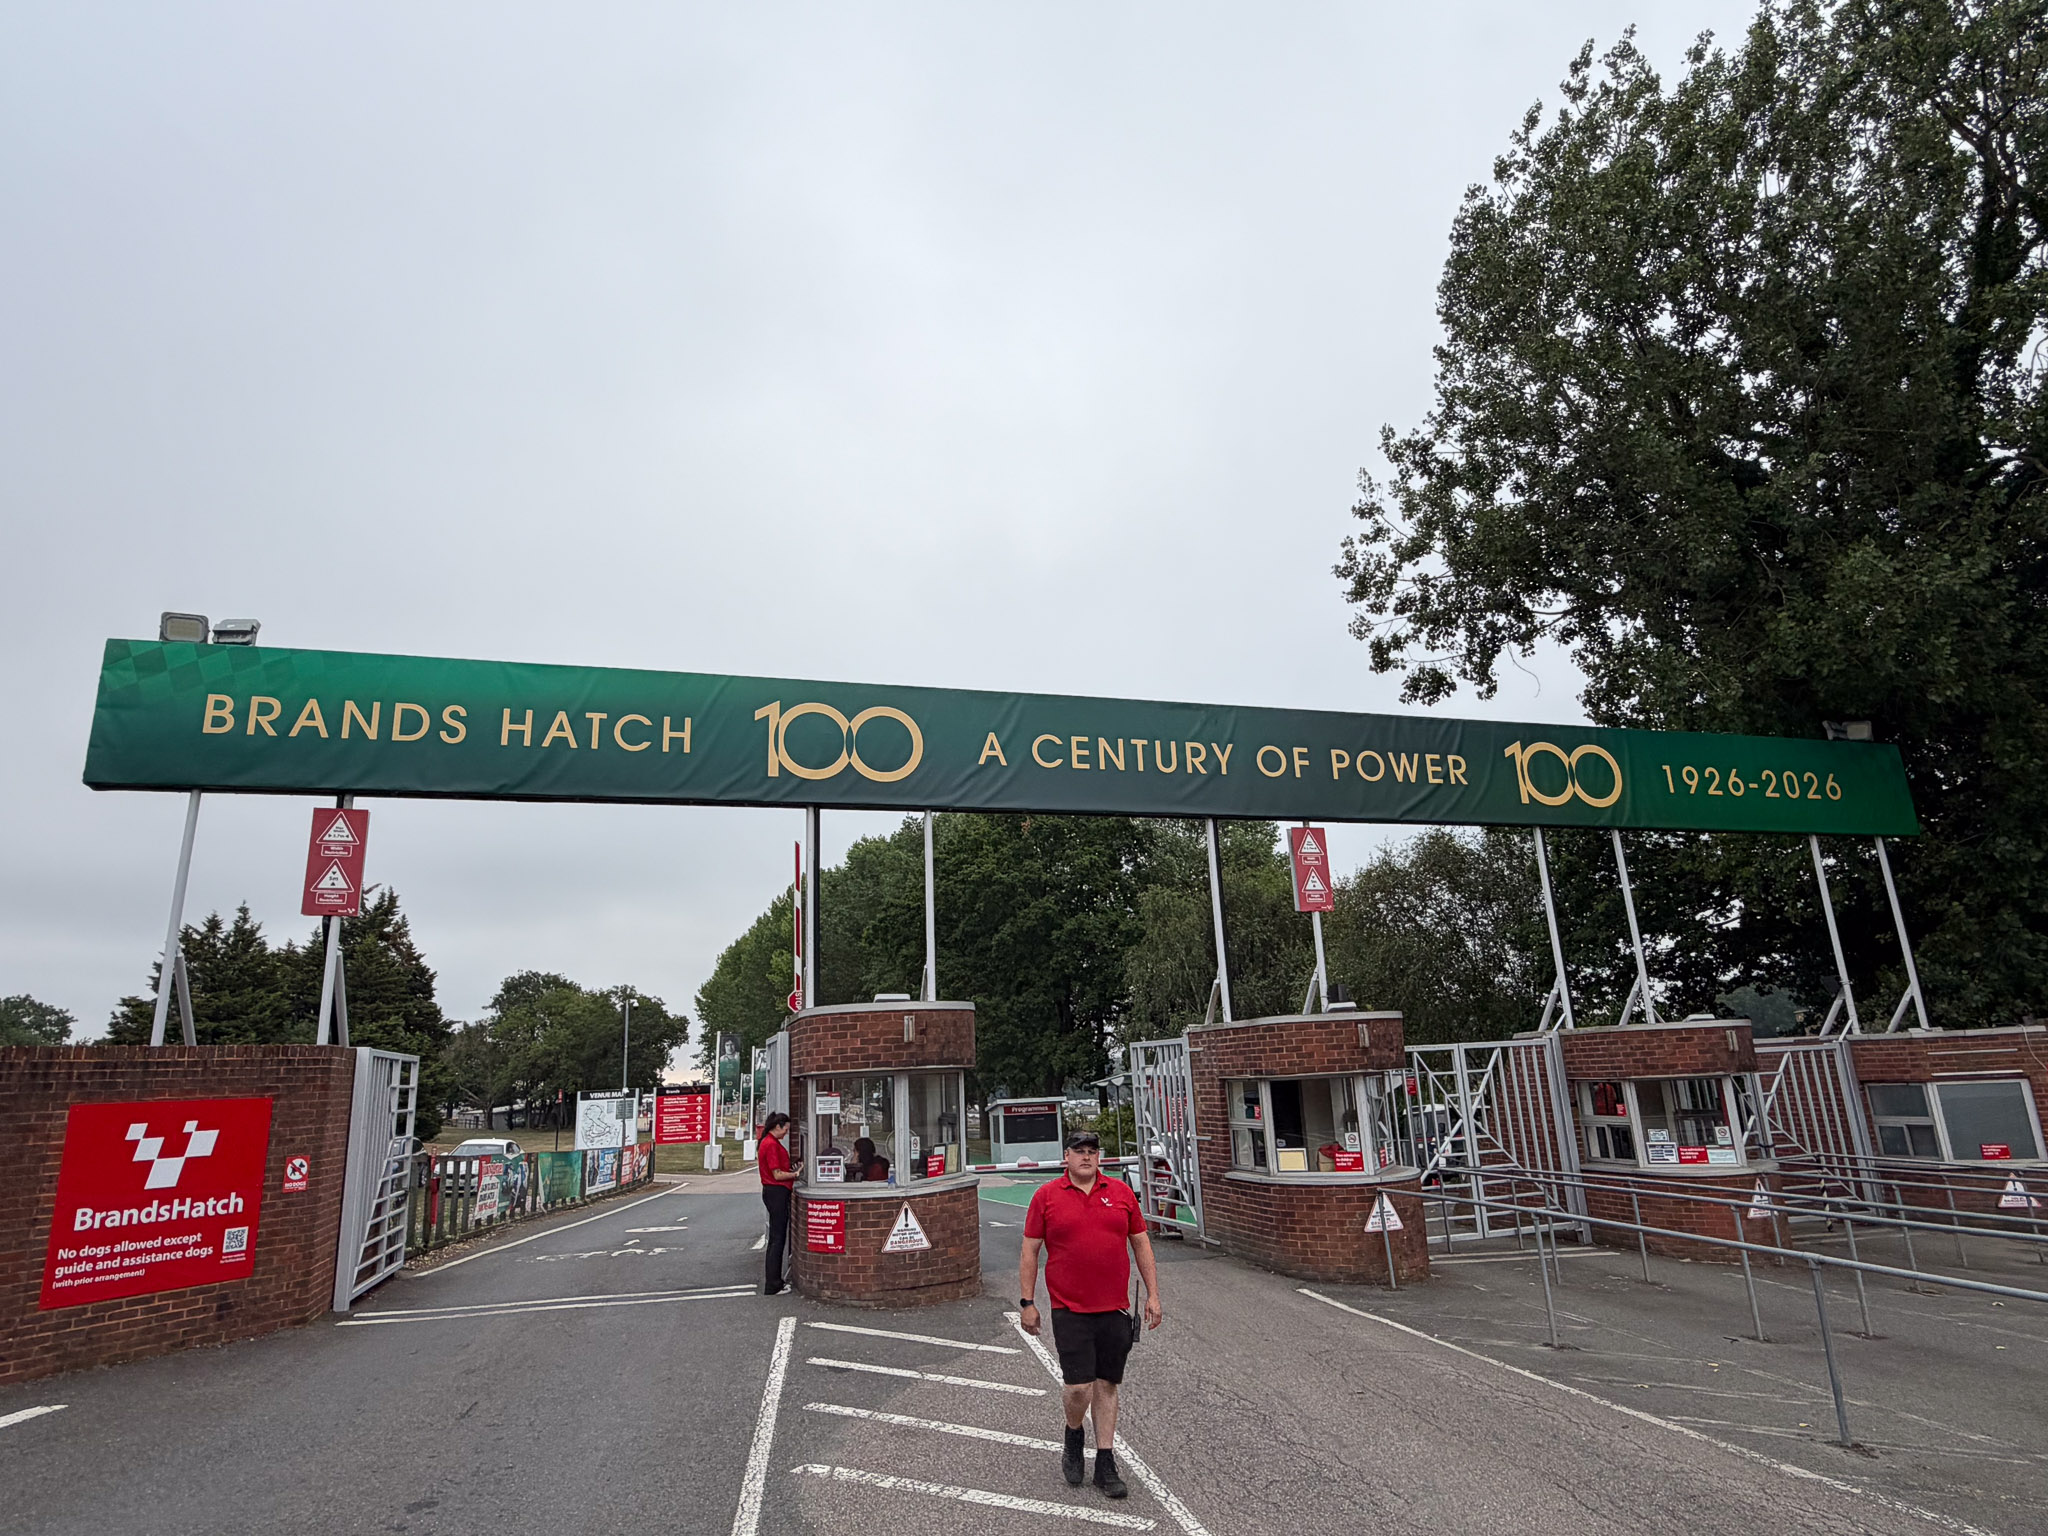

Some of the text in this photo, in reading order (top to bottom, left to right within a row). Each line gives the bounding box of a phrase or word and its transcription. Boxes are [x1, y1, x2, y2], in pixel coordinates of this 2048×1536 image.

[203, 695, 1841, 808] BRANDS HATCH 100 A CENTURY OF POWER 100 1926-2026
[73, 1192, 244, 1231] BrandsHatch
[54, 1259, 93, 1278] guide
[95, 1256, 120, 1270] and
[122, 1248, 183, 1266] assistance
[185, 1246, 214, 1259] dogs
[57, 1233, 202, 1260] No dogs allowed except
[52, 1268, 146, 1290] (with prior arrangement)
